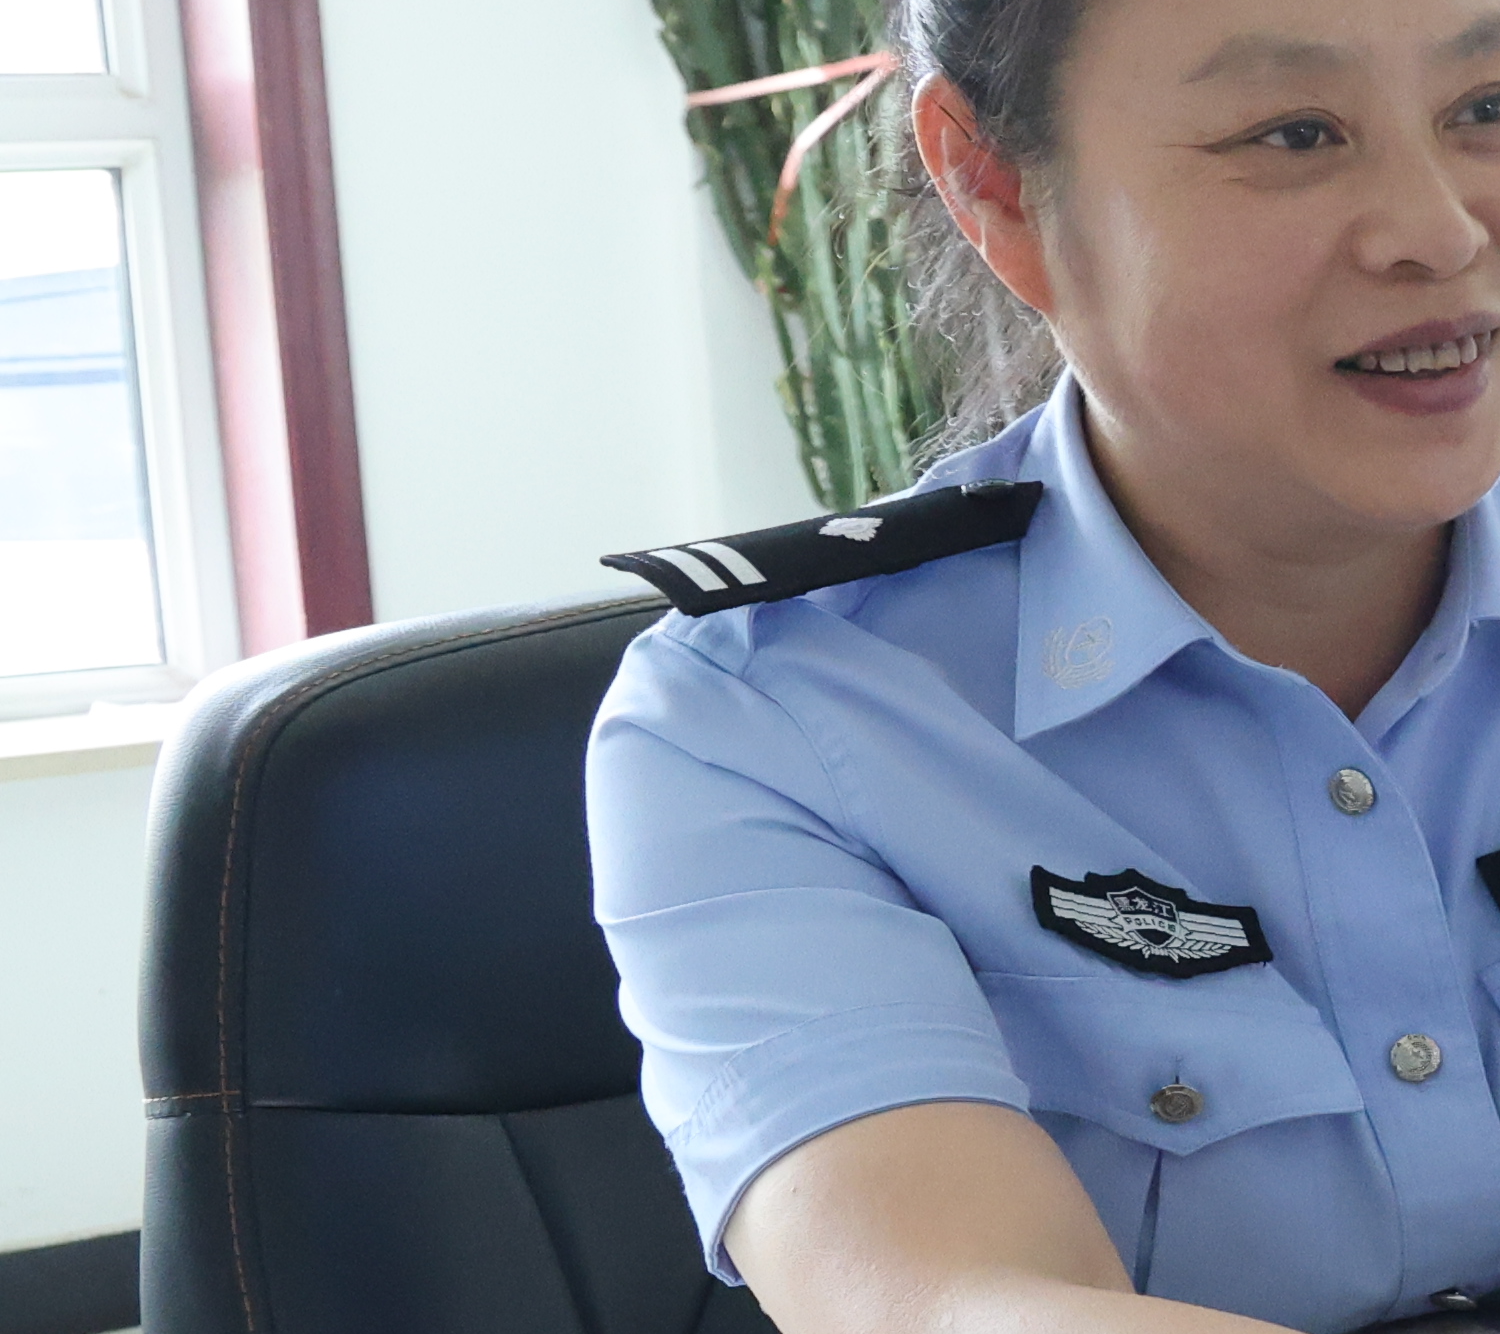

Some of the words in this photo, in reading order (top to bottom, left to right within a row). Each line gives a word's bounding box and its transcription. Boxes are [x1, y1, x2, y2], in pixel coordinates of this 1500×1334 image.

[1113, 895, 1171, 917] 黑龙江
[1124, 916, 1177, 934] POLICE
